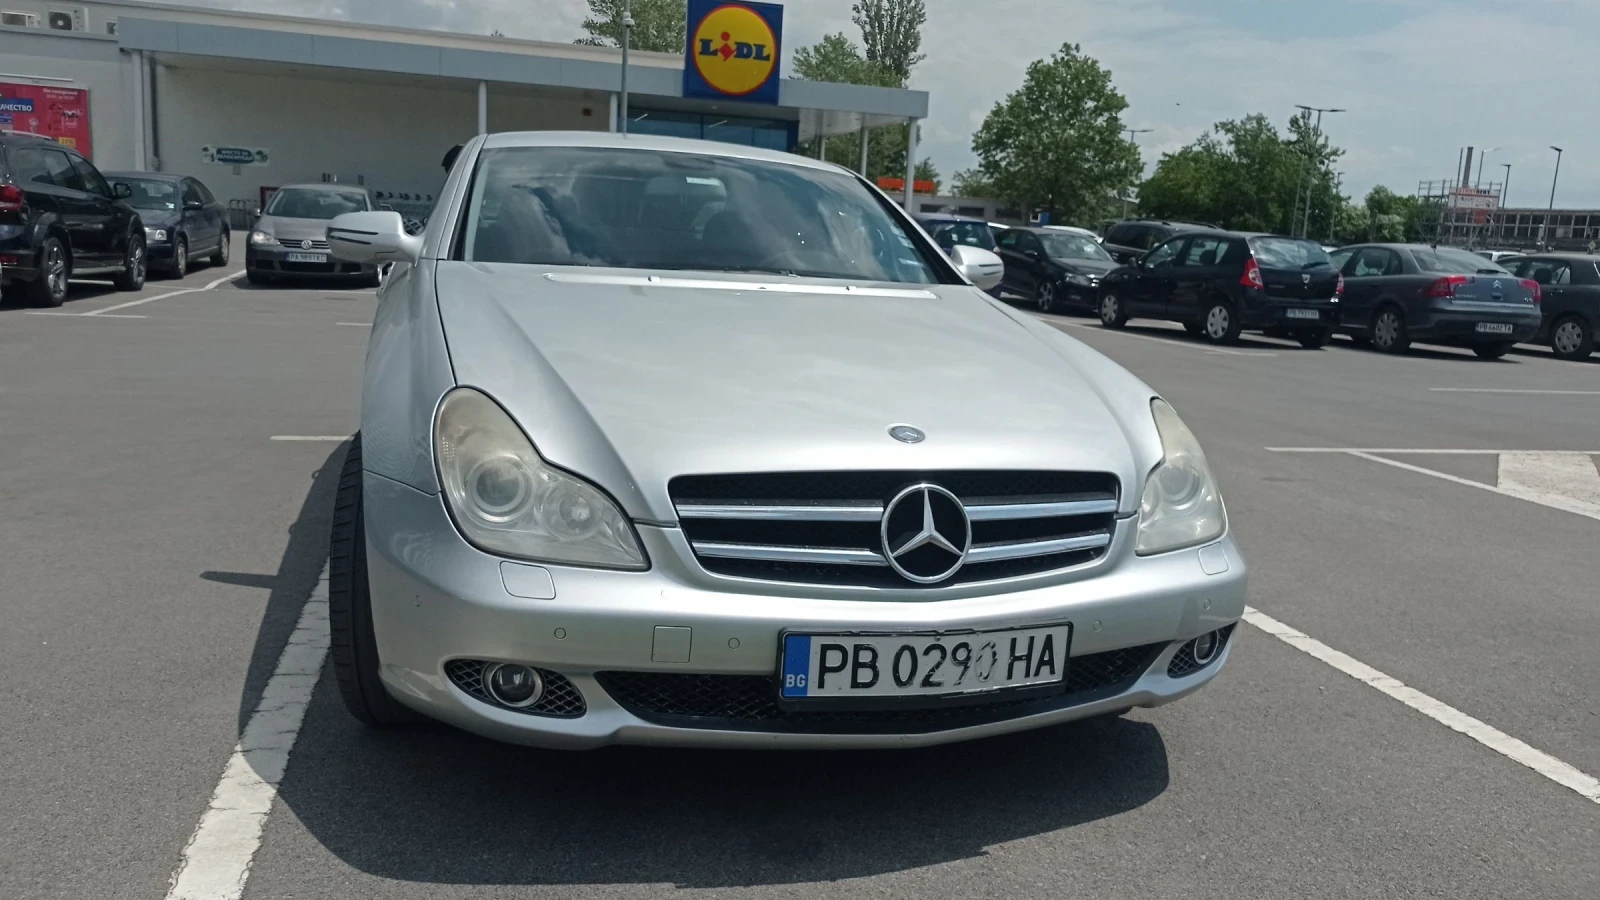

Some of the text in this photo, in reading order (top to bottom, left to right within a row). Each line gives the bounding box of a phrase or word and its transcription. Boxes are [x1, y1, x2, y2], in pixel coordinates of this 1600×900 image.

[0, 103, 32, 112] АЧЕСТВО
[817, 643, 880, 689] PB
[1006, 633, 1056, 680] HA
[785, 673, 806, 687] BG
